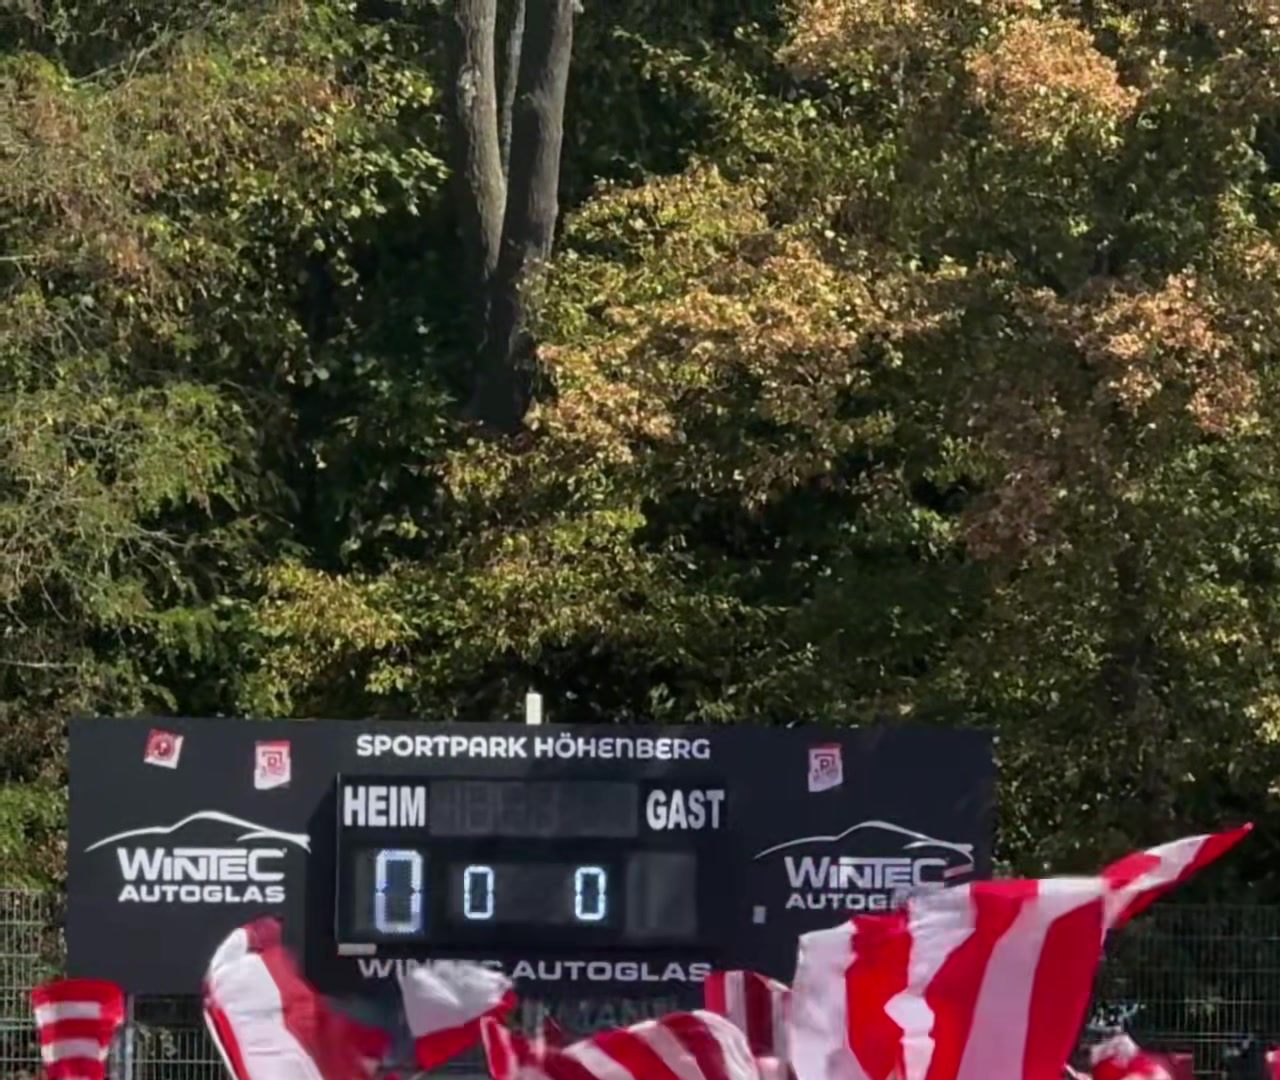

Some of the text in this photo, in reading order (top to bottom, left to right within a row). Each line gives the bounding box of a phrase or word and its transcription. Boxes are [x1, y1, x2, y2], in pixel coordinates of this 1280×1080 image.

[356, 732, 711, 760] SPORTPARK HÖHENBERG
[343, 785, 426, 827] HEIM
[646, 789, 725, 830] GAST
[117, 847, 285, 882] WINTEC
[118, 884, 286, 903] AUTOGLAS
[375, 849, 423, 934] 0
[463, 865, 494, 919] 0
[575, 866, 606, 920] 0
[511, 960, 712, 982] AUTOGLAS
